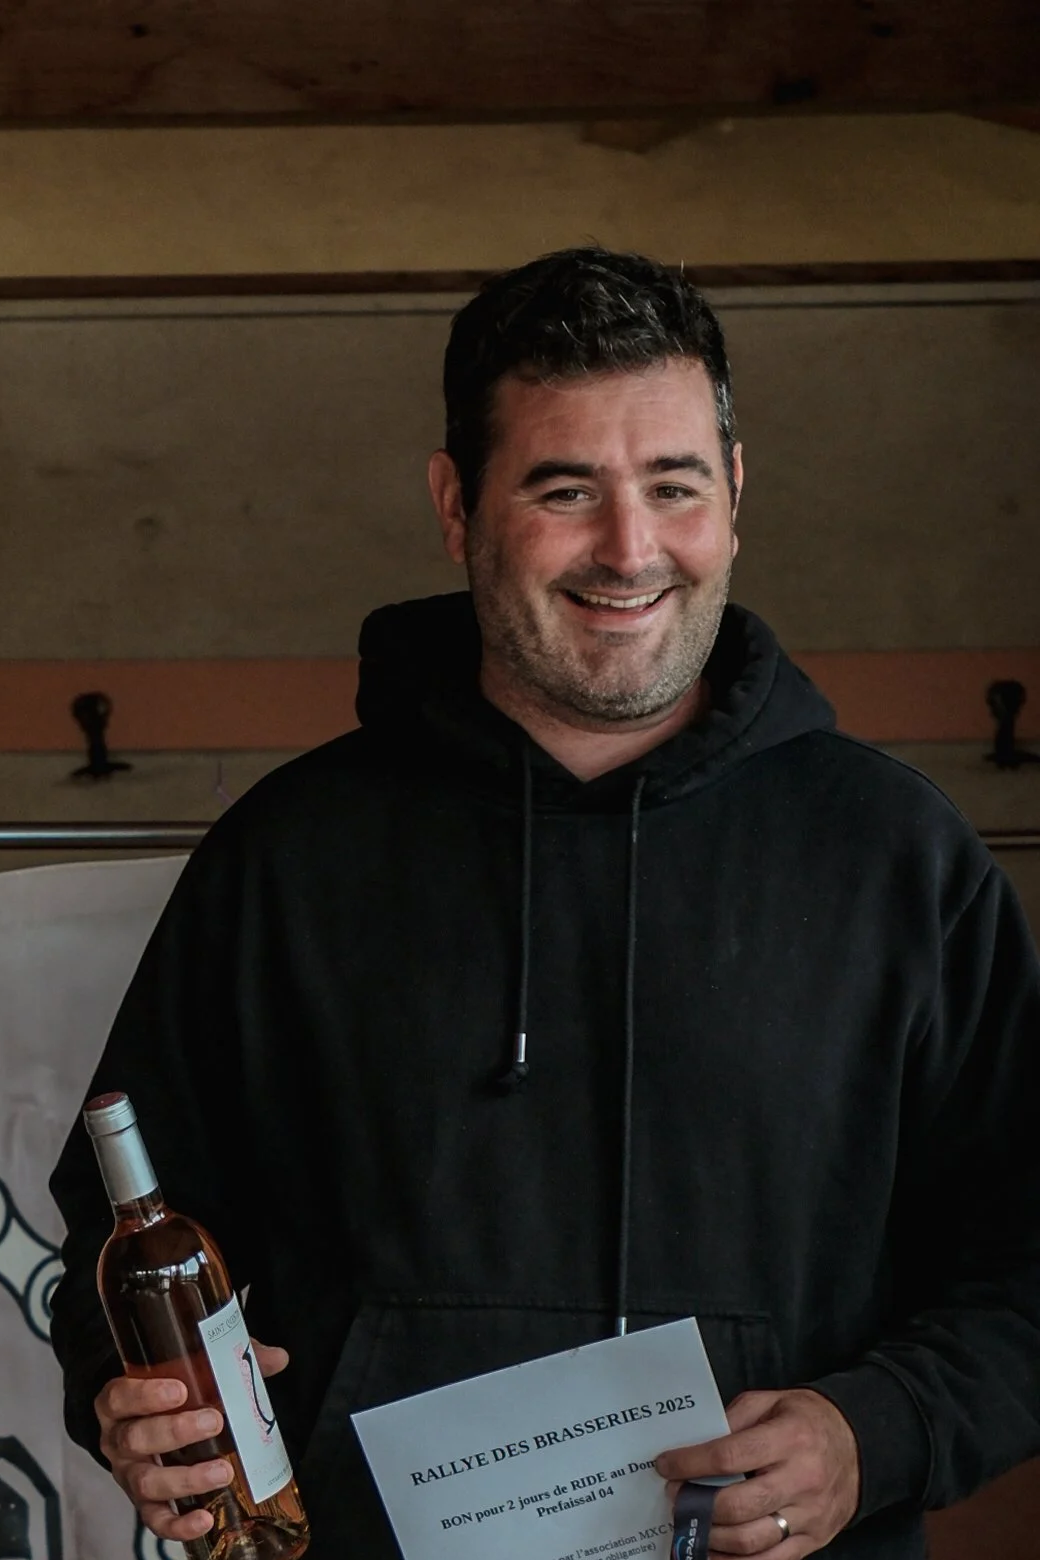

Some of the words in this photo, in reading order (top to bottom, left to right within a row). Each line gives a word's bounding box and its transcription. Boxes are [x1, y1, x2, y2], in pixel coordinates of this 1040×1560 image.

[411, 1452, 490, 1486] RALLYE
[492, 1440, 531, 1462] DES
[533, 1404, 653, 1450] BRASSERIES
[655, 1395, 696, 1416] 2025
[440, 1512, 474, 1530] BON
[475, 1505, 506, 1523] pour
[507, 1499, 516, 1511] 2
[517, 1491, 551, 1511] jours
[553, 1483, 568, 1497] de
[570, 1472, 608, 1491] RIDE
[610, 1467, 626, 1480] au
[628, 1459, 657, 1474] Dom
[536, 1491, 598, 1518] Prefaissal
[598, 1485, 616, 1499] 04
[638, 1525, 668, 1541] MXC
